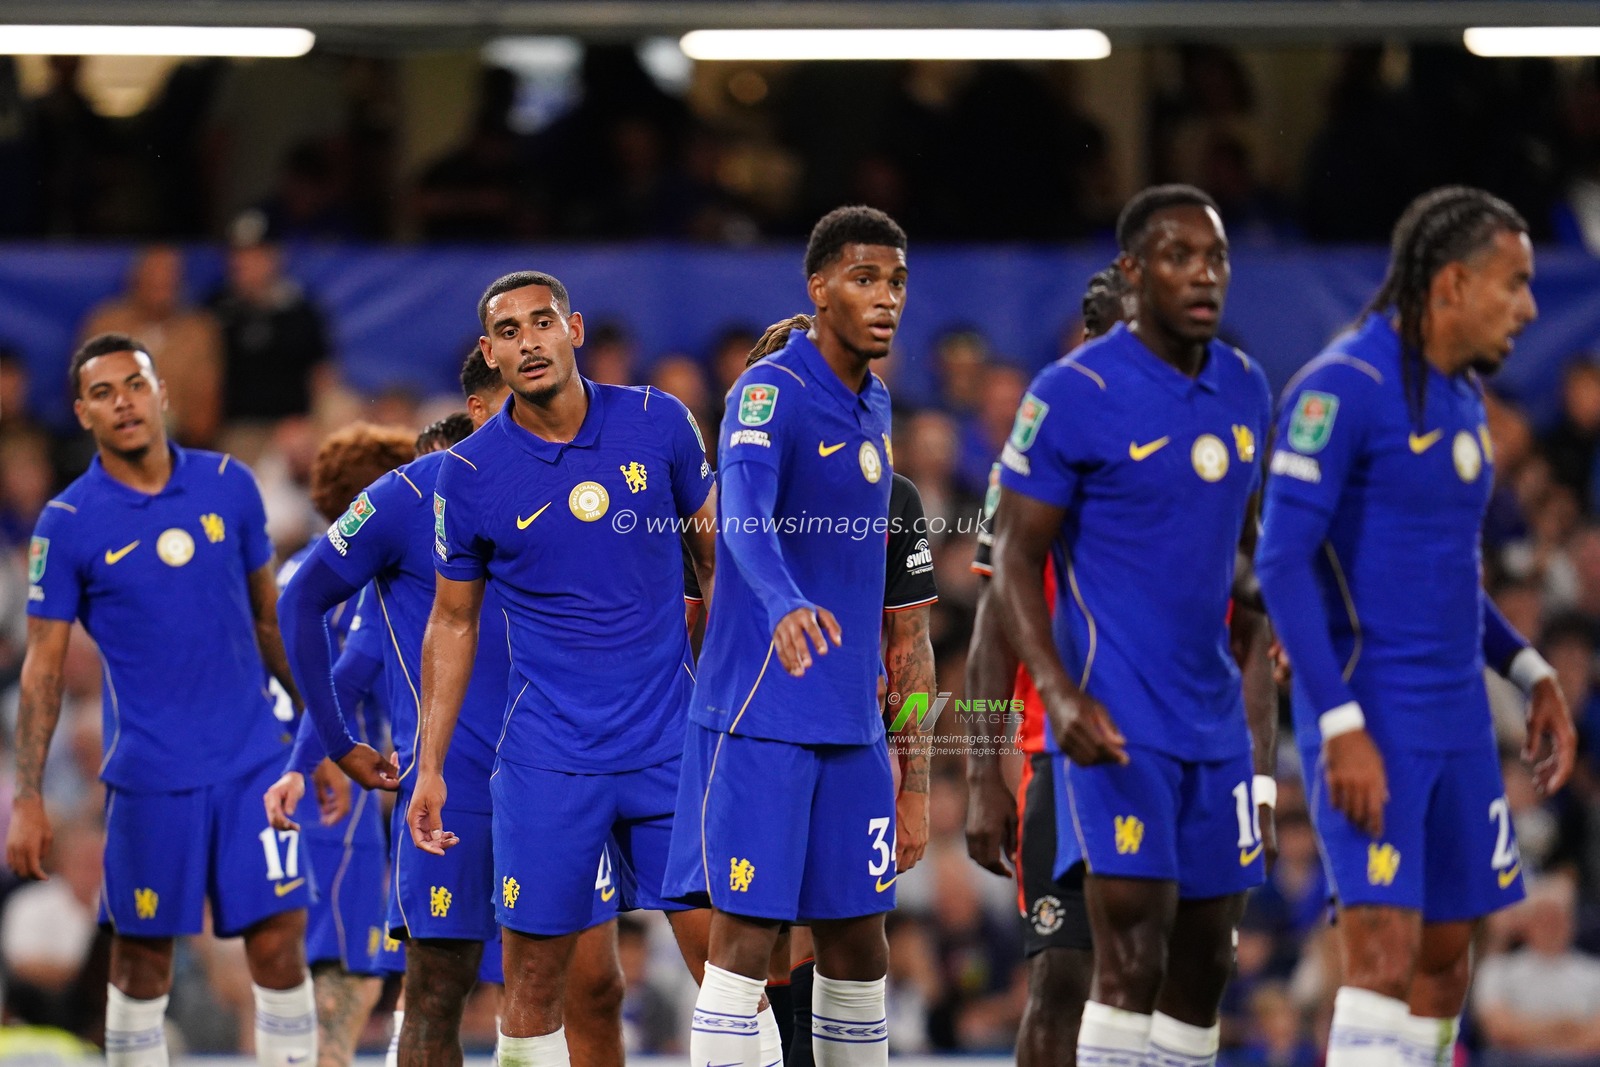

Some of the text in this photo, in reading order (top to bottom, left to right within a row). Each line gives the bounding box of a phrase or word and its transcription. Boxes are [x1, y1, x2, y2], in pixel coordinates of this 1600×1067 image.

[572, 484, 606, 511] WORLD CHAMPIONS
[585, 509, 601, 519] FIFA
[1232, 780, 1262, 848] 1
[1488, 796, 1520, 870] 2
[259, 826, 299, 880] 17
